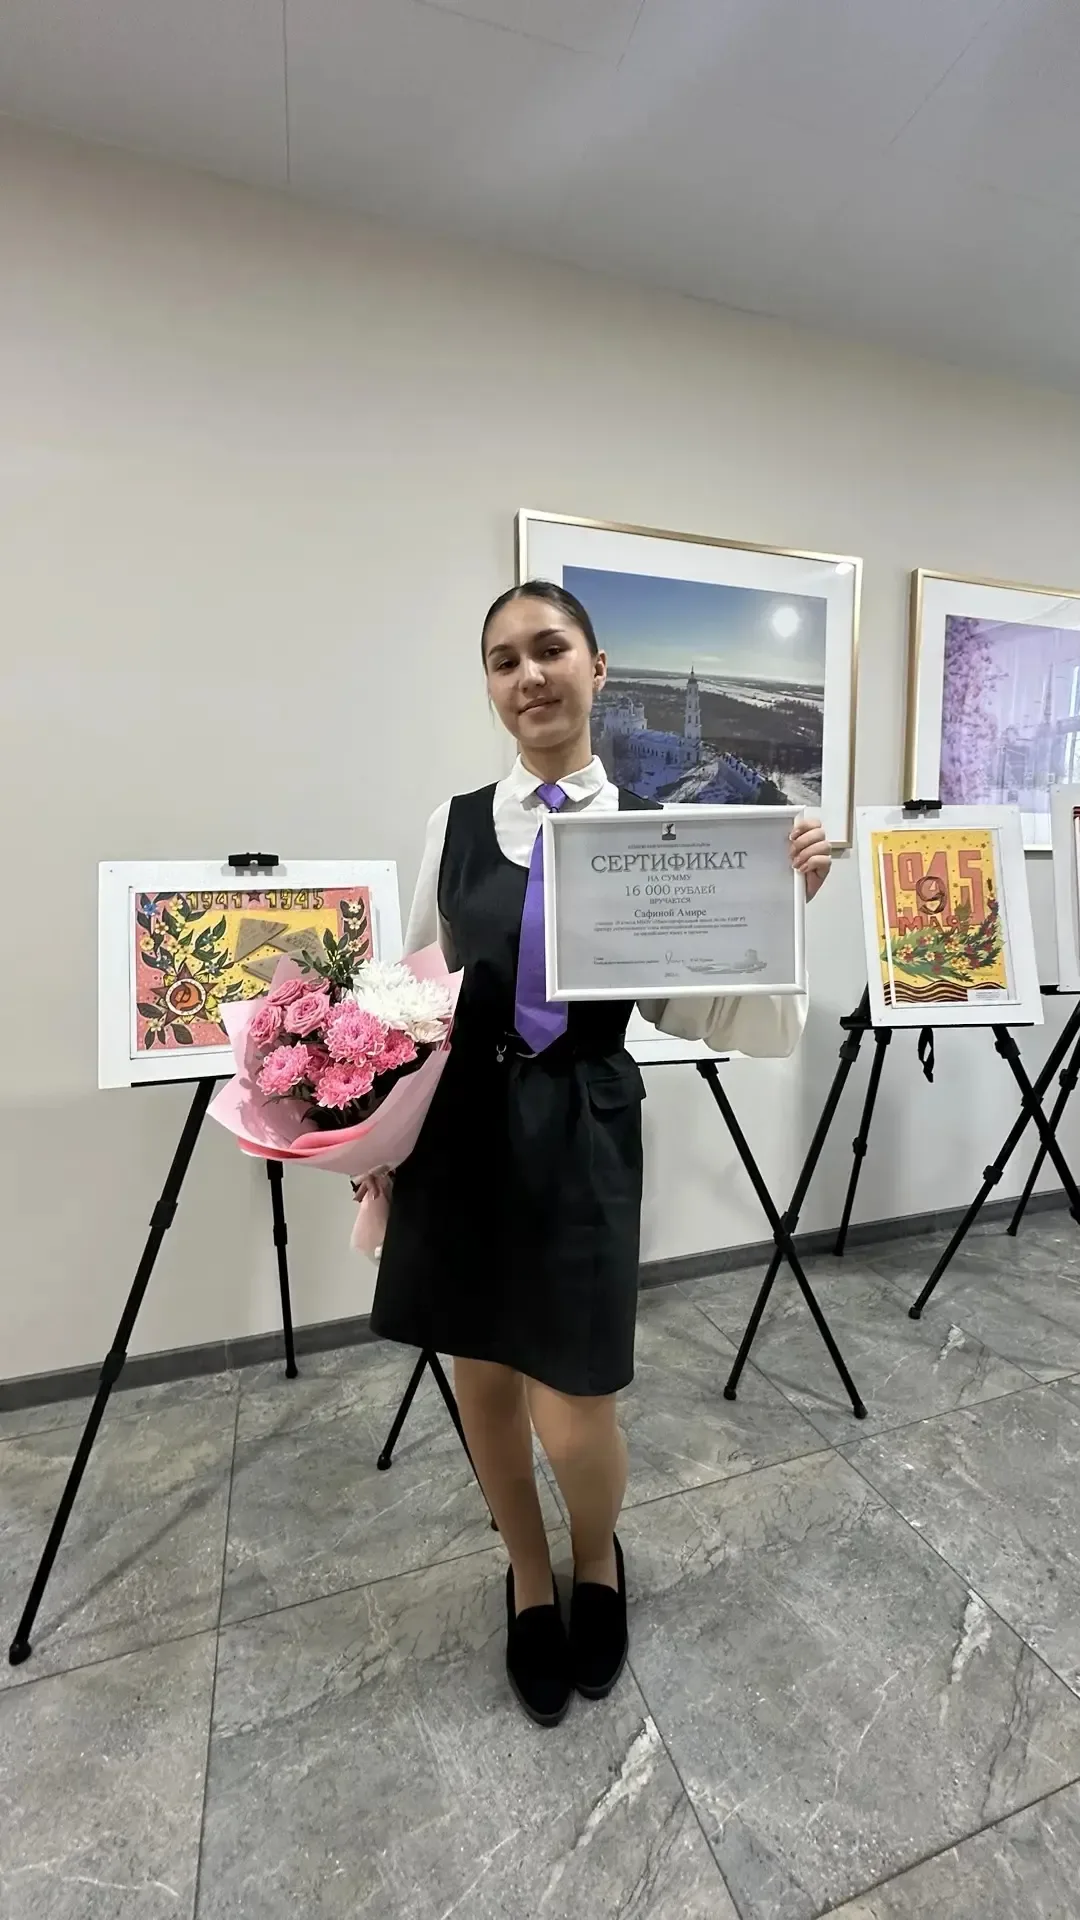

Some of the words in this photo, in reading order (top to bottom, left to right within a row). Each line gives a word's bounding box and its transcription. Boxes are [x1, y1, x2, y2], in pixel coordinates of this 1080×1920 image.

[591, 851, 748, 873] СЕРТИФИКАТ
[661, 874, 692, 882] СУММУ
[625, 885, 641, 896] 16
[645, 884, 671, 896] 000
[674, 884, 716, 895] РУБЛЕЙ
[186, 891, 243, 910] 1941
[265, 888, 324, 910] 1945
[649, 897, 691, 905] ВРУЧАЕТСЯ
[634, 908, 675, 919] Сафиной
[677, 909, 707, 919] Амире
